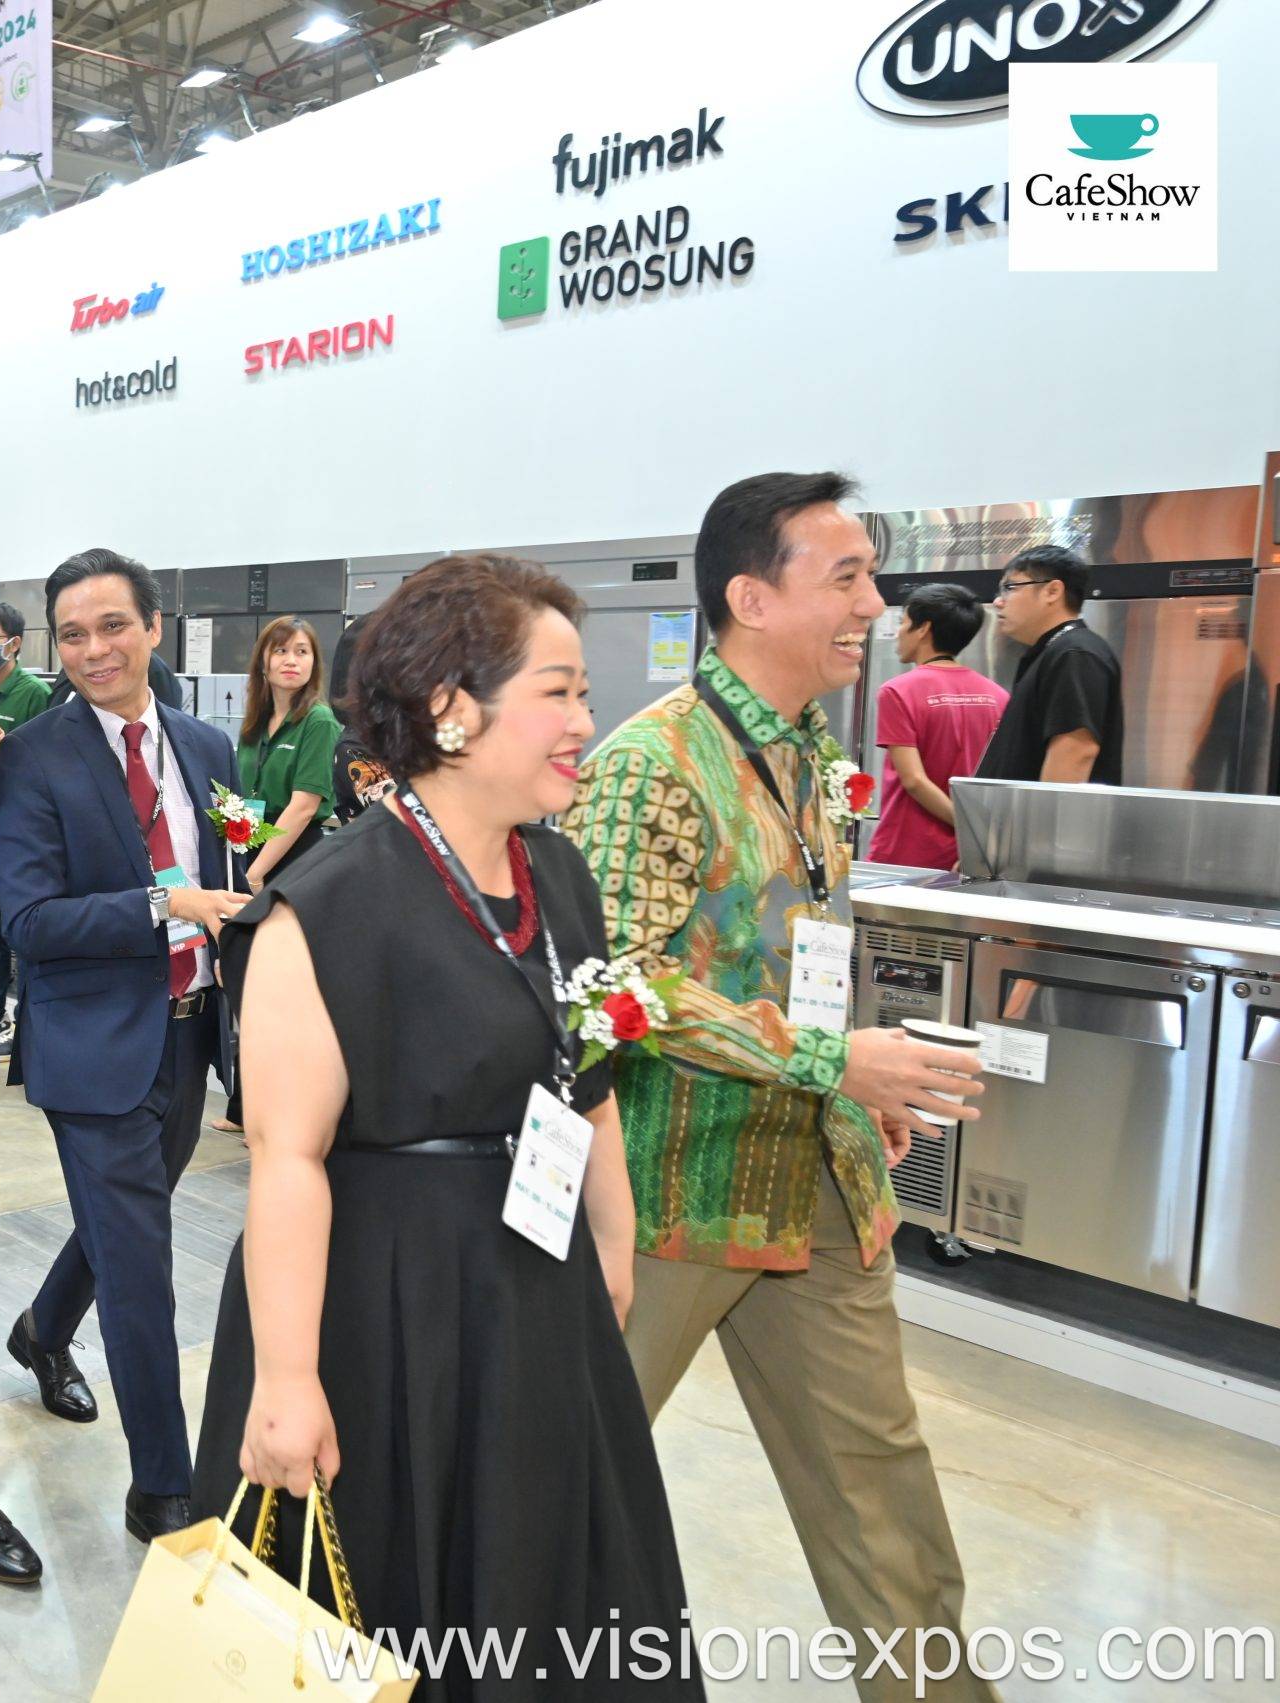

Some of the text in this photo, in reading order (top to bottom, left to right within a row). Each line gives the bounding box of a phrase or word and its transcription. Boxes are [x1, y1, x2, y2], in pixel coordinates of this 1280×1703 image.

[551, 106, 725, 197] fujimak
[240, 197, 442, 282] HOSHIZAKI
[558, 204, 690, 267] GRAND
[558, 236, 755, 309] WOOSUNG
[70, 281, 166, 332] Turbo air
[244, 314, 394, 376] STARION
[75, 355, 178, 408] hot&cold
[411, 805, 451, 856] CafeShow
[170, 943, 186, 953] VIP
